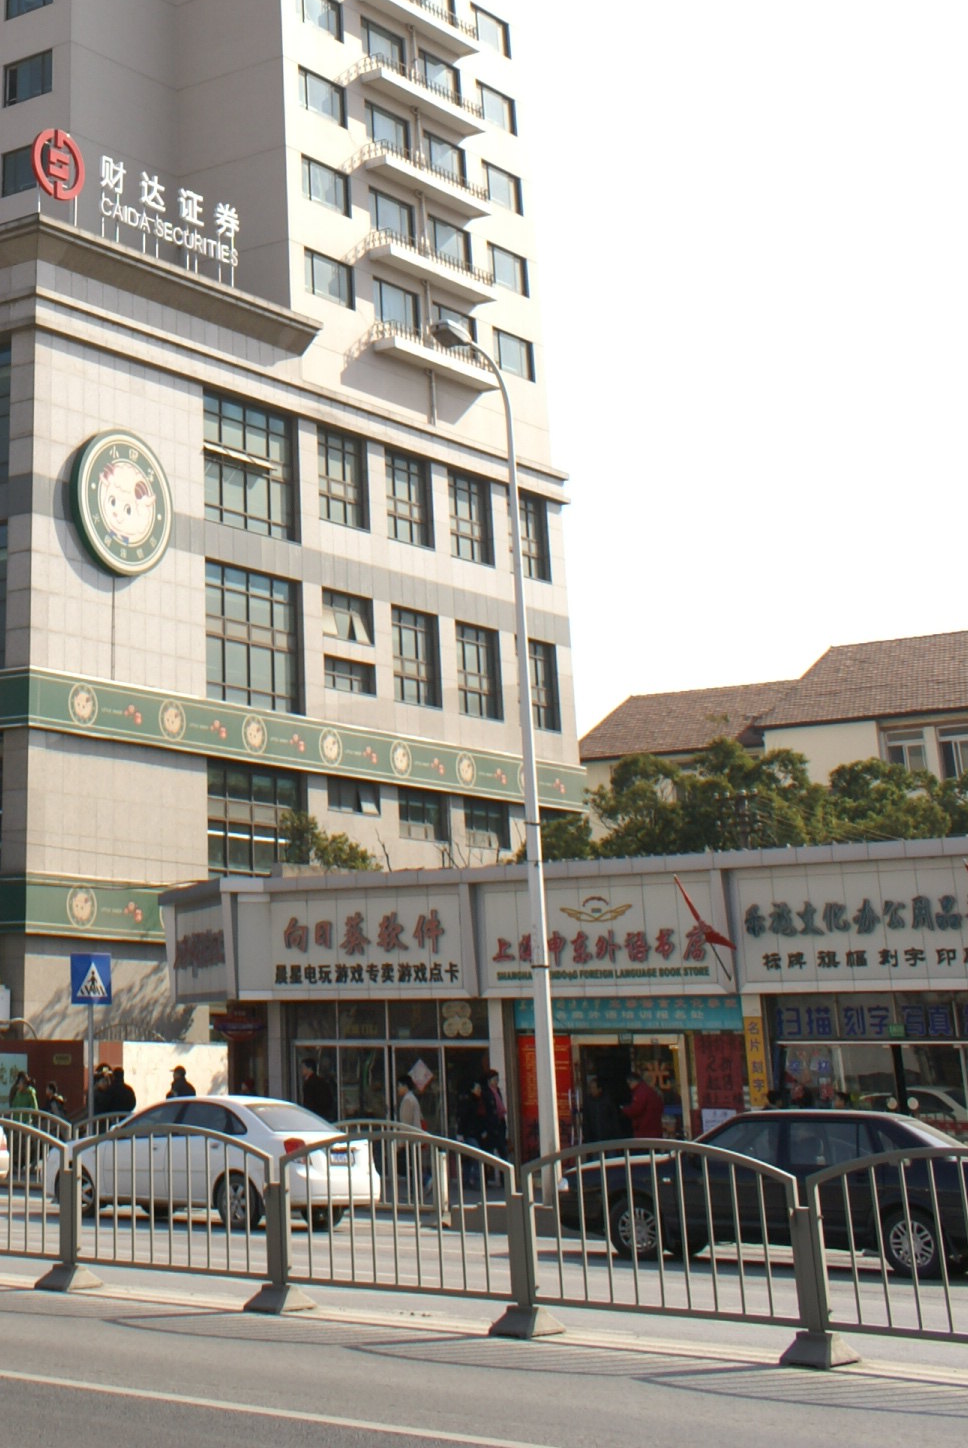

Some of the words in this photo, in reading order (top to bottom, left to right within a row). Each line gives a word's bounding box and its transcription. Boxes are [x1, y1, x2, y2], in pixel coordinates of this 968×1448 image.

[100, 155, 240, 238] 财达证券
[100, 197, 150, 234] CAIDA
[153, 217, 240, 268] SECURITIES
[283, 909, 445, 955] 向日葵软件
[496, 970, 532, 982] SHANGHA
[614, 967, 658, 980] LANGUAGE
[658, 966, 682, 978] BOOK
[683, 965, 710, 978] STORE
[776, 1005, 833, 1038] 扫描
[844, 1004, 890, 1036] 刻字
